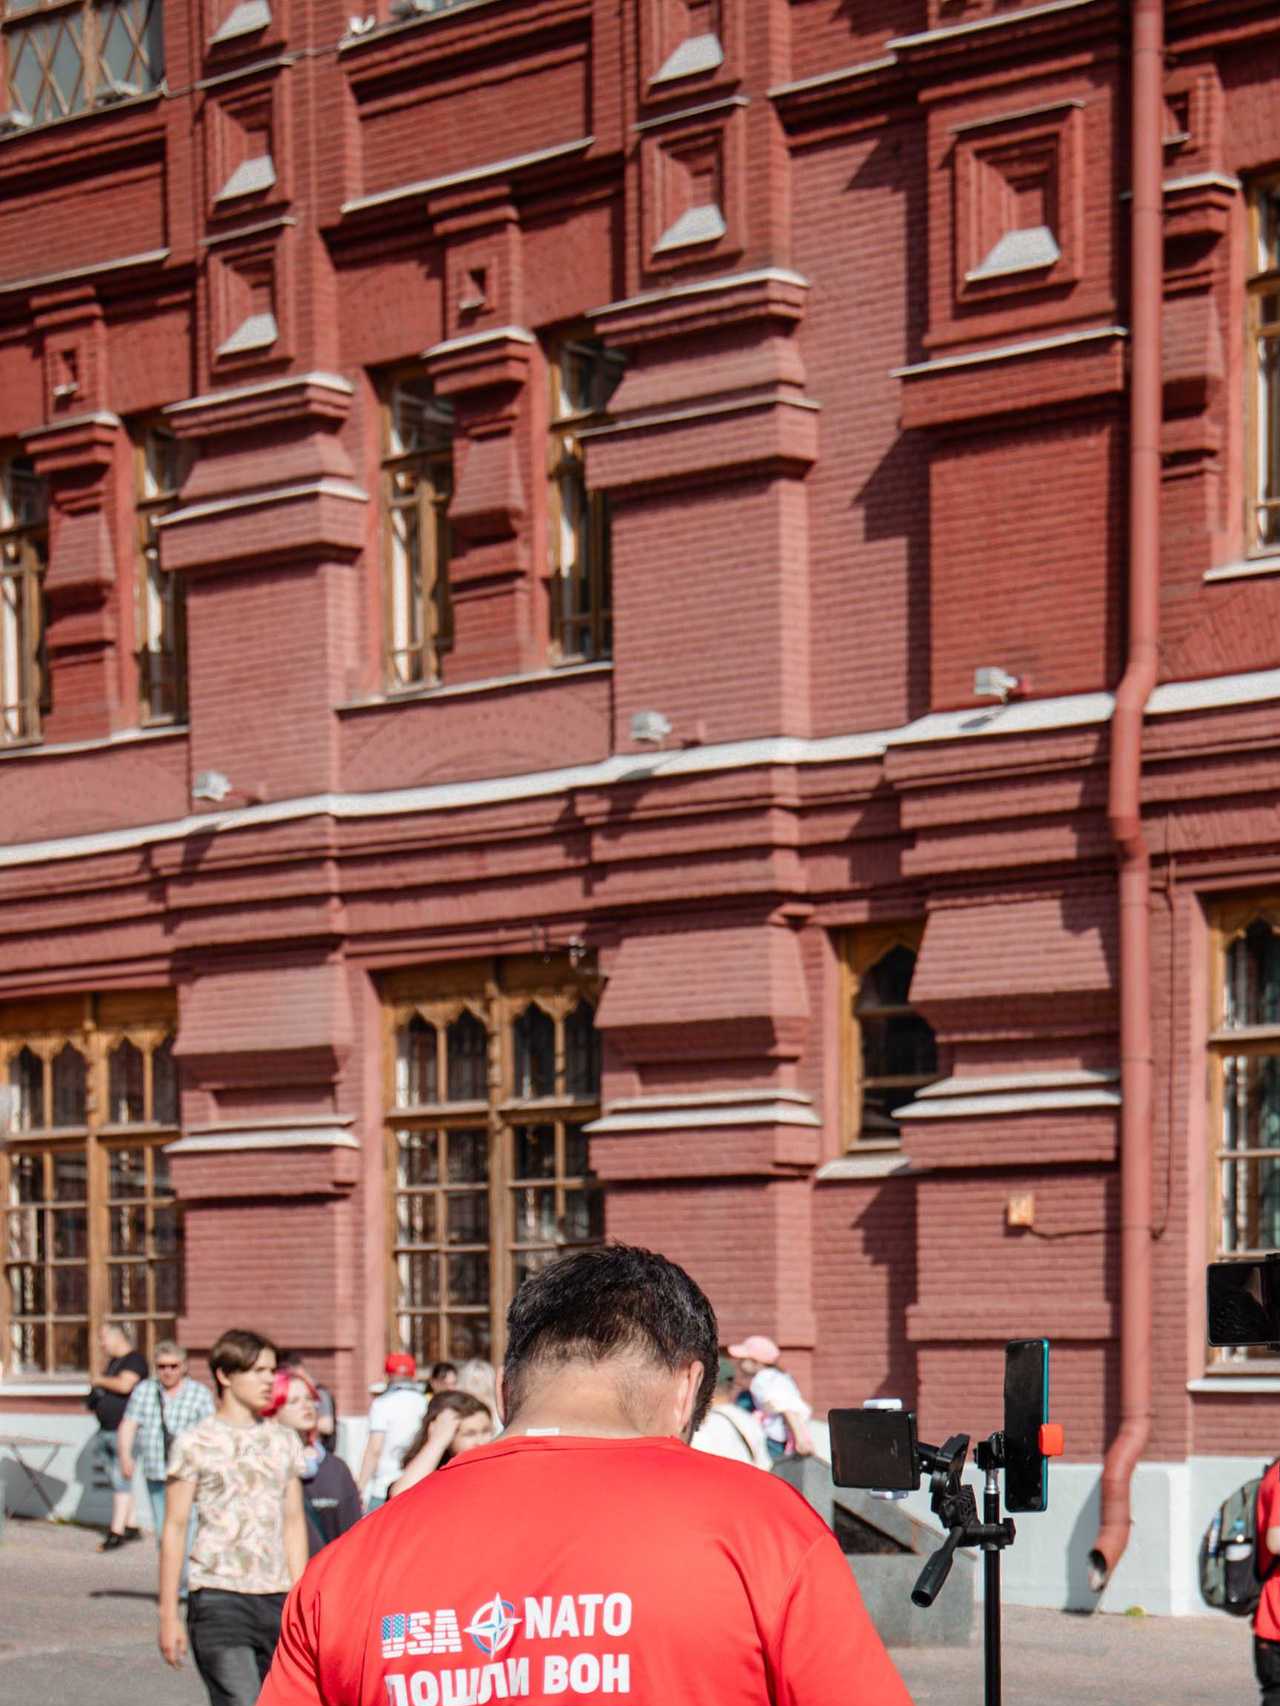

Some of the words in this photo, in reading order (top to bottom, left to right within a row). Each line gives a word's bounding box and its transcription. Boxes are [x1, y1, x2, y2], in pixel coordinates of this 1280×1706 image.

[381, 1608, 463, 1659] USA
[524, 1592, 633, 1640] NATO
[543, 1653, 631, 1695] ВОН
